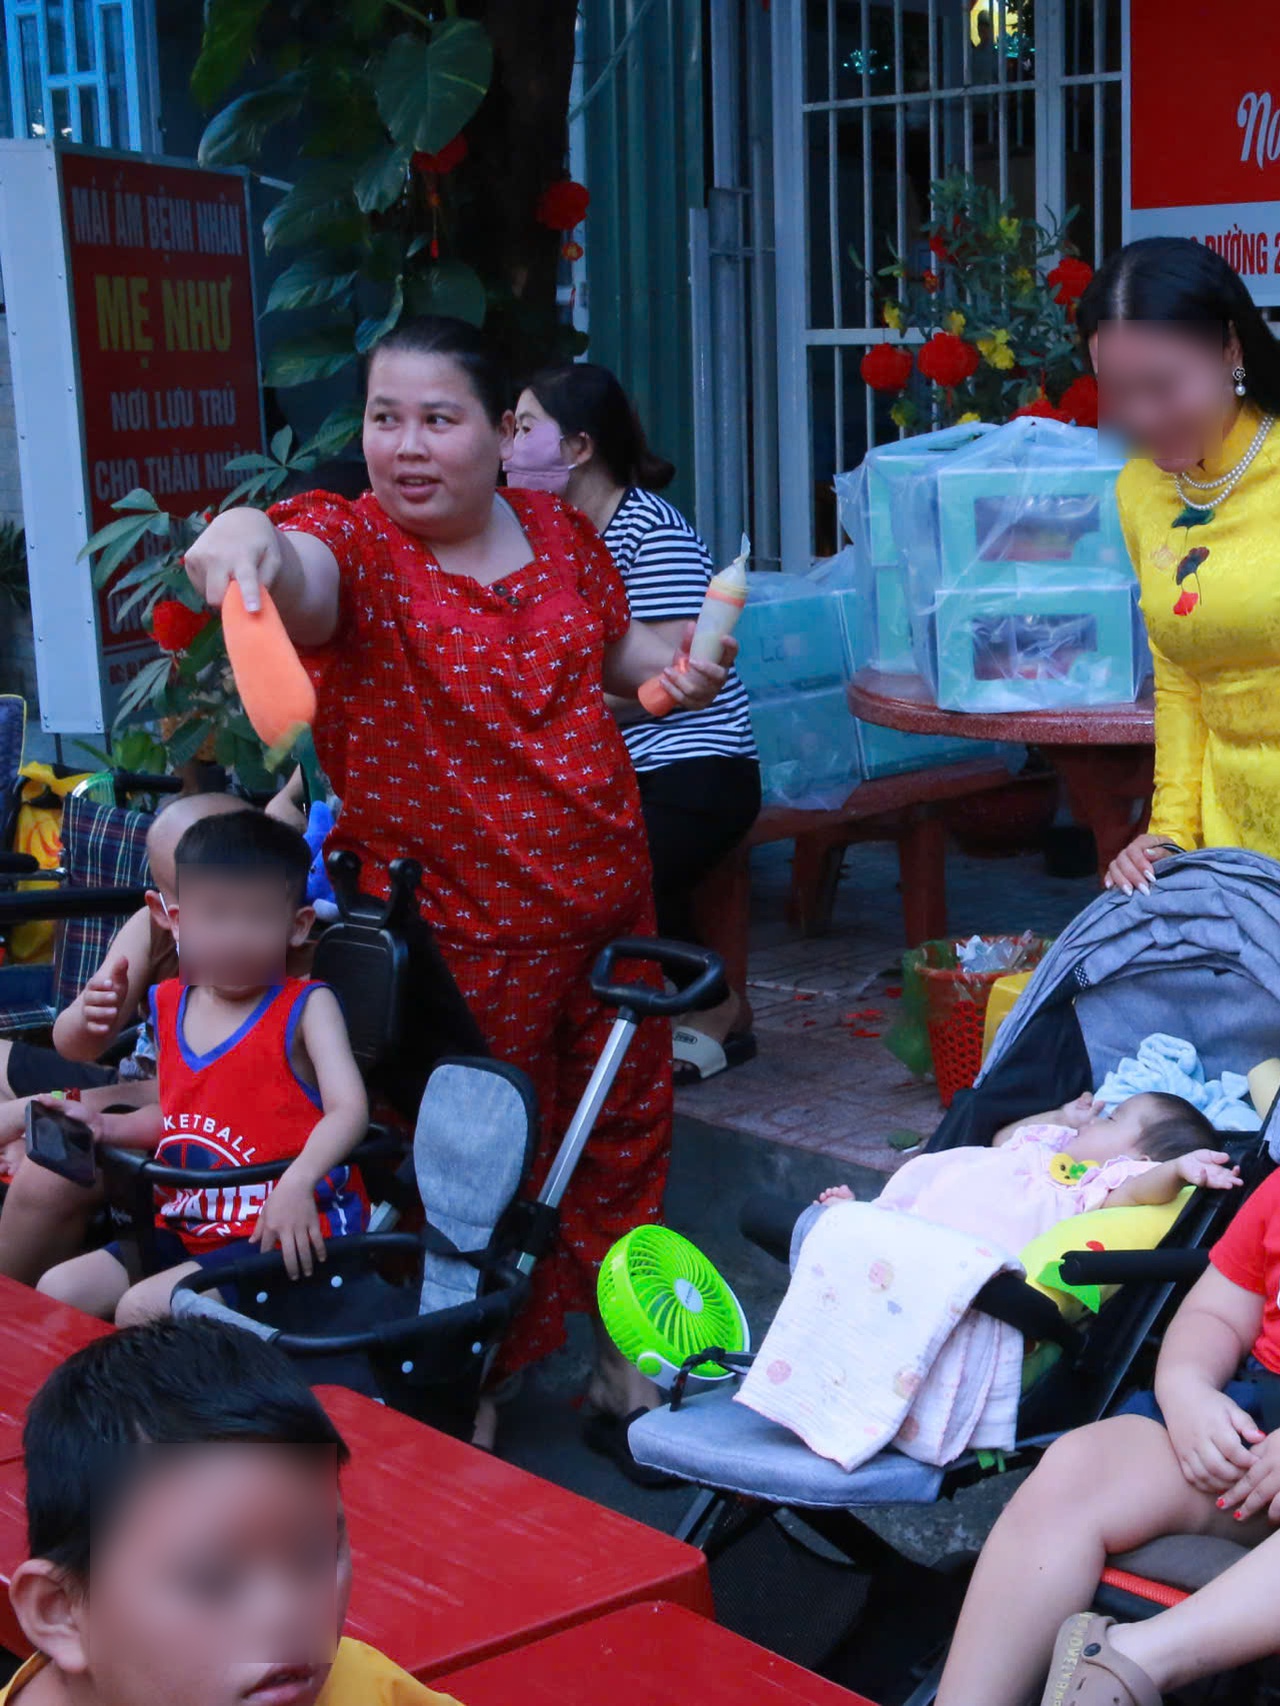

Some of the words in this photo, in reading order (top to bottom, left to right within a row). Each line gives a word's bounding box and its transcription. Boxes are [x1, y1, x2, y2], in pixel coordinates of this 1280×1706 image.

[146, 184, 195, 265] BỆNH
[95, 276, 153, 368] MẸ
[162, 276, 232, 352] NHƯ
[111, 387, 150, 432] NƠI
